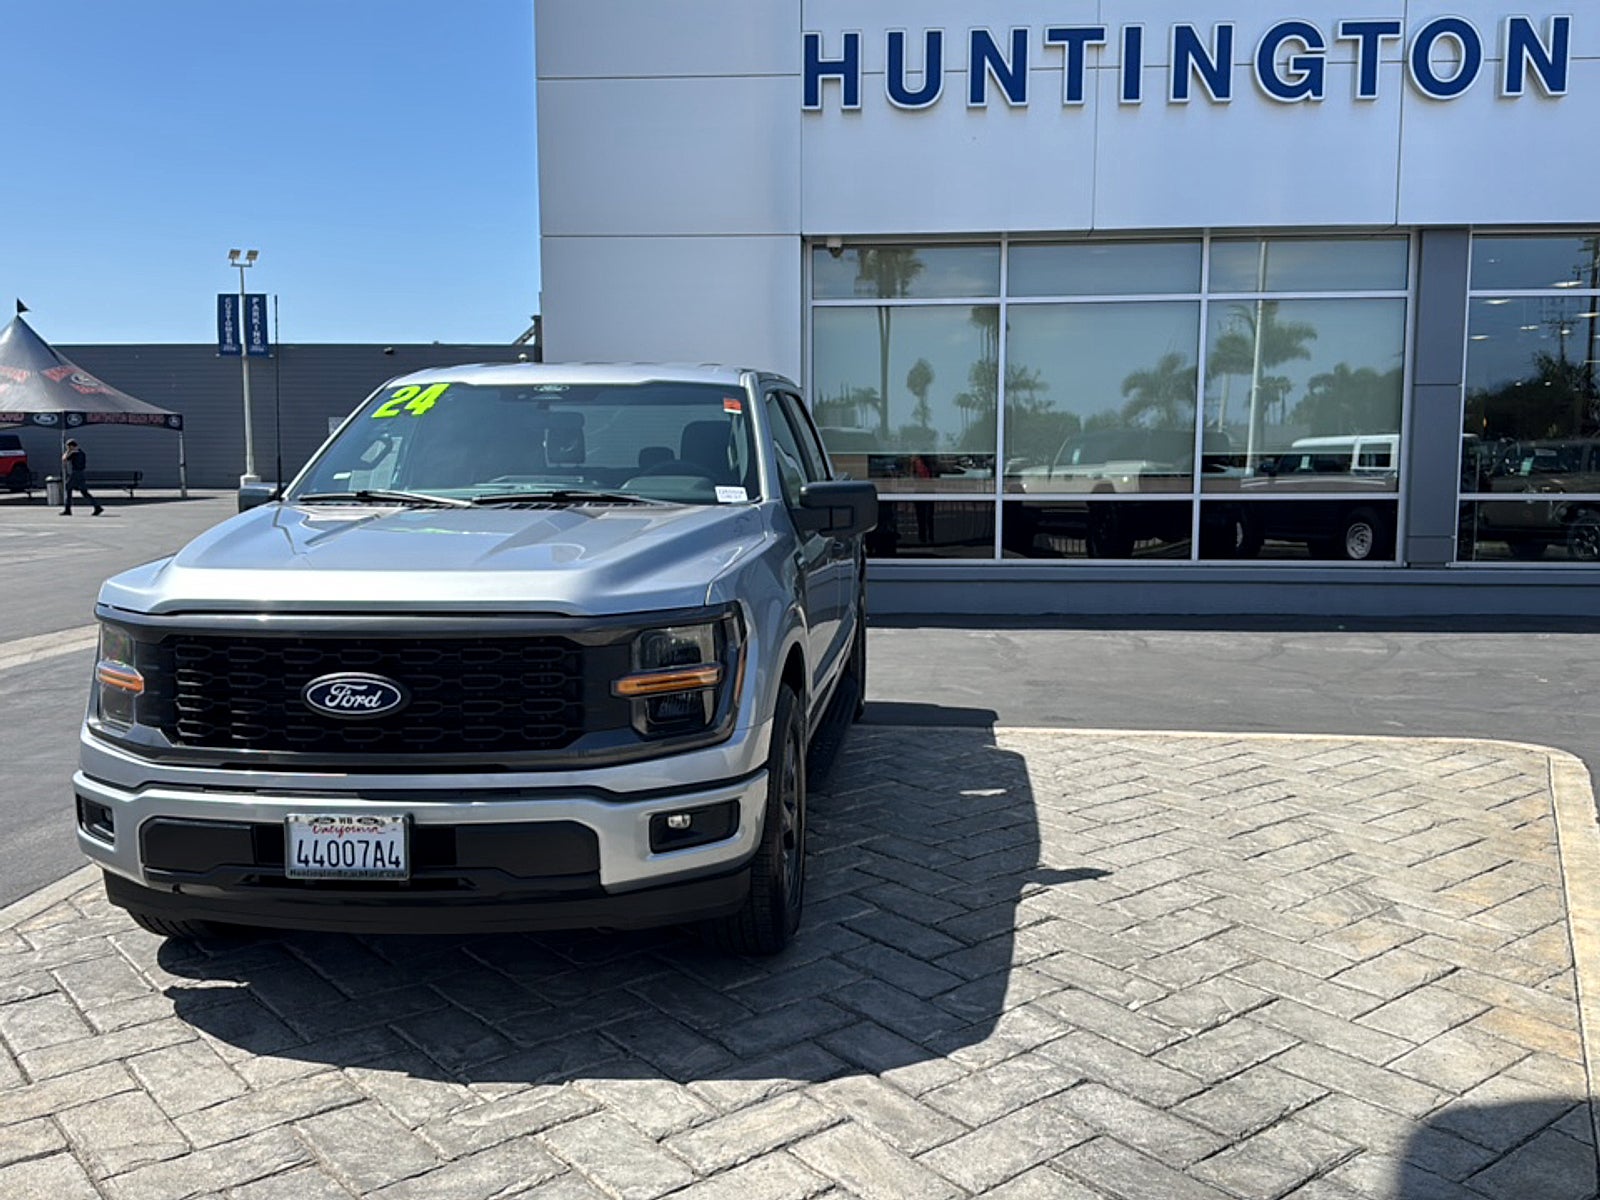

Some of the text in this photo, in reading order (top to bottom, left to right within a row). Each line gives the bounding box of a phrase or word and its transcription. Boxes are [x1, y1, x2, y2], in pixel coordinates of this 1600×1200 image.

[802, 15, 1571, 110] HUNTINGTON
[224, 297, 233, 345] CUSTOMER
[251, 296, 261, 345] PARKING
[371, 383, 450, 419] 24
[324, 683, 383, 708] Ford
[312, 825, 385, 838] California
[296, 839, 401, 868] 44007A4
